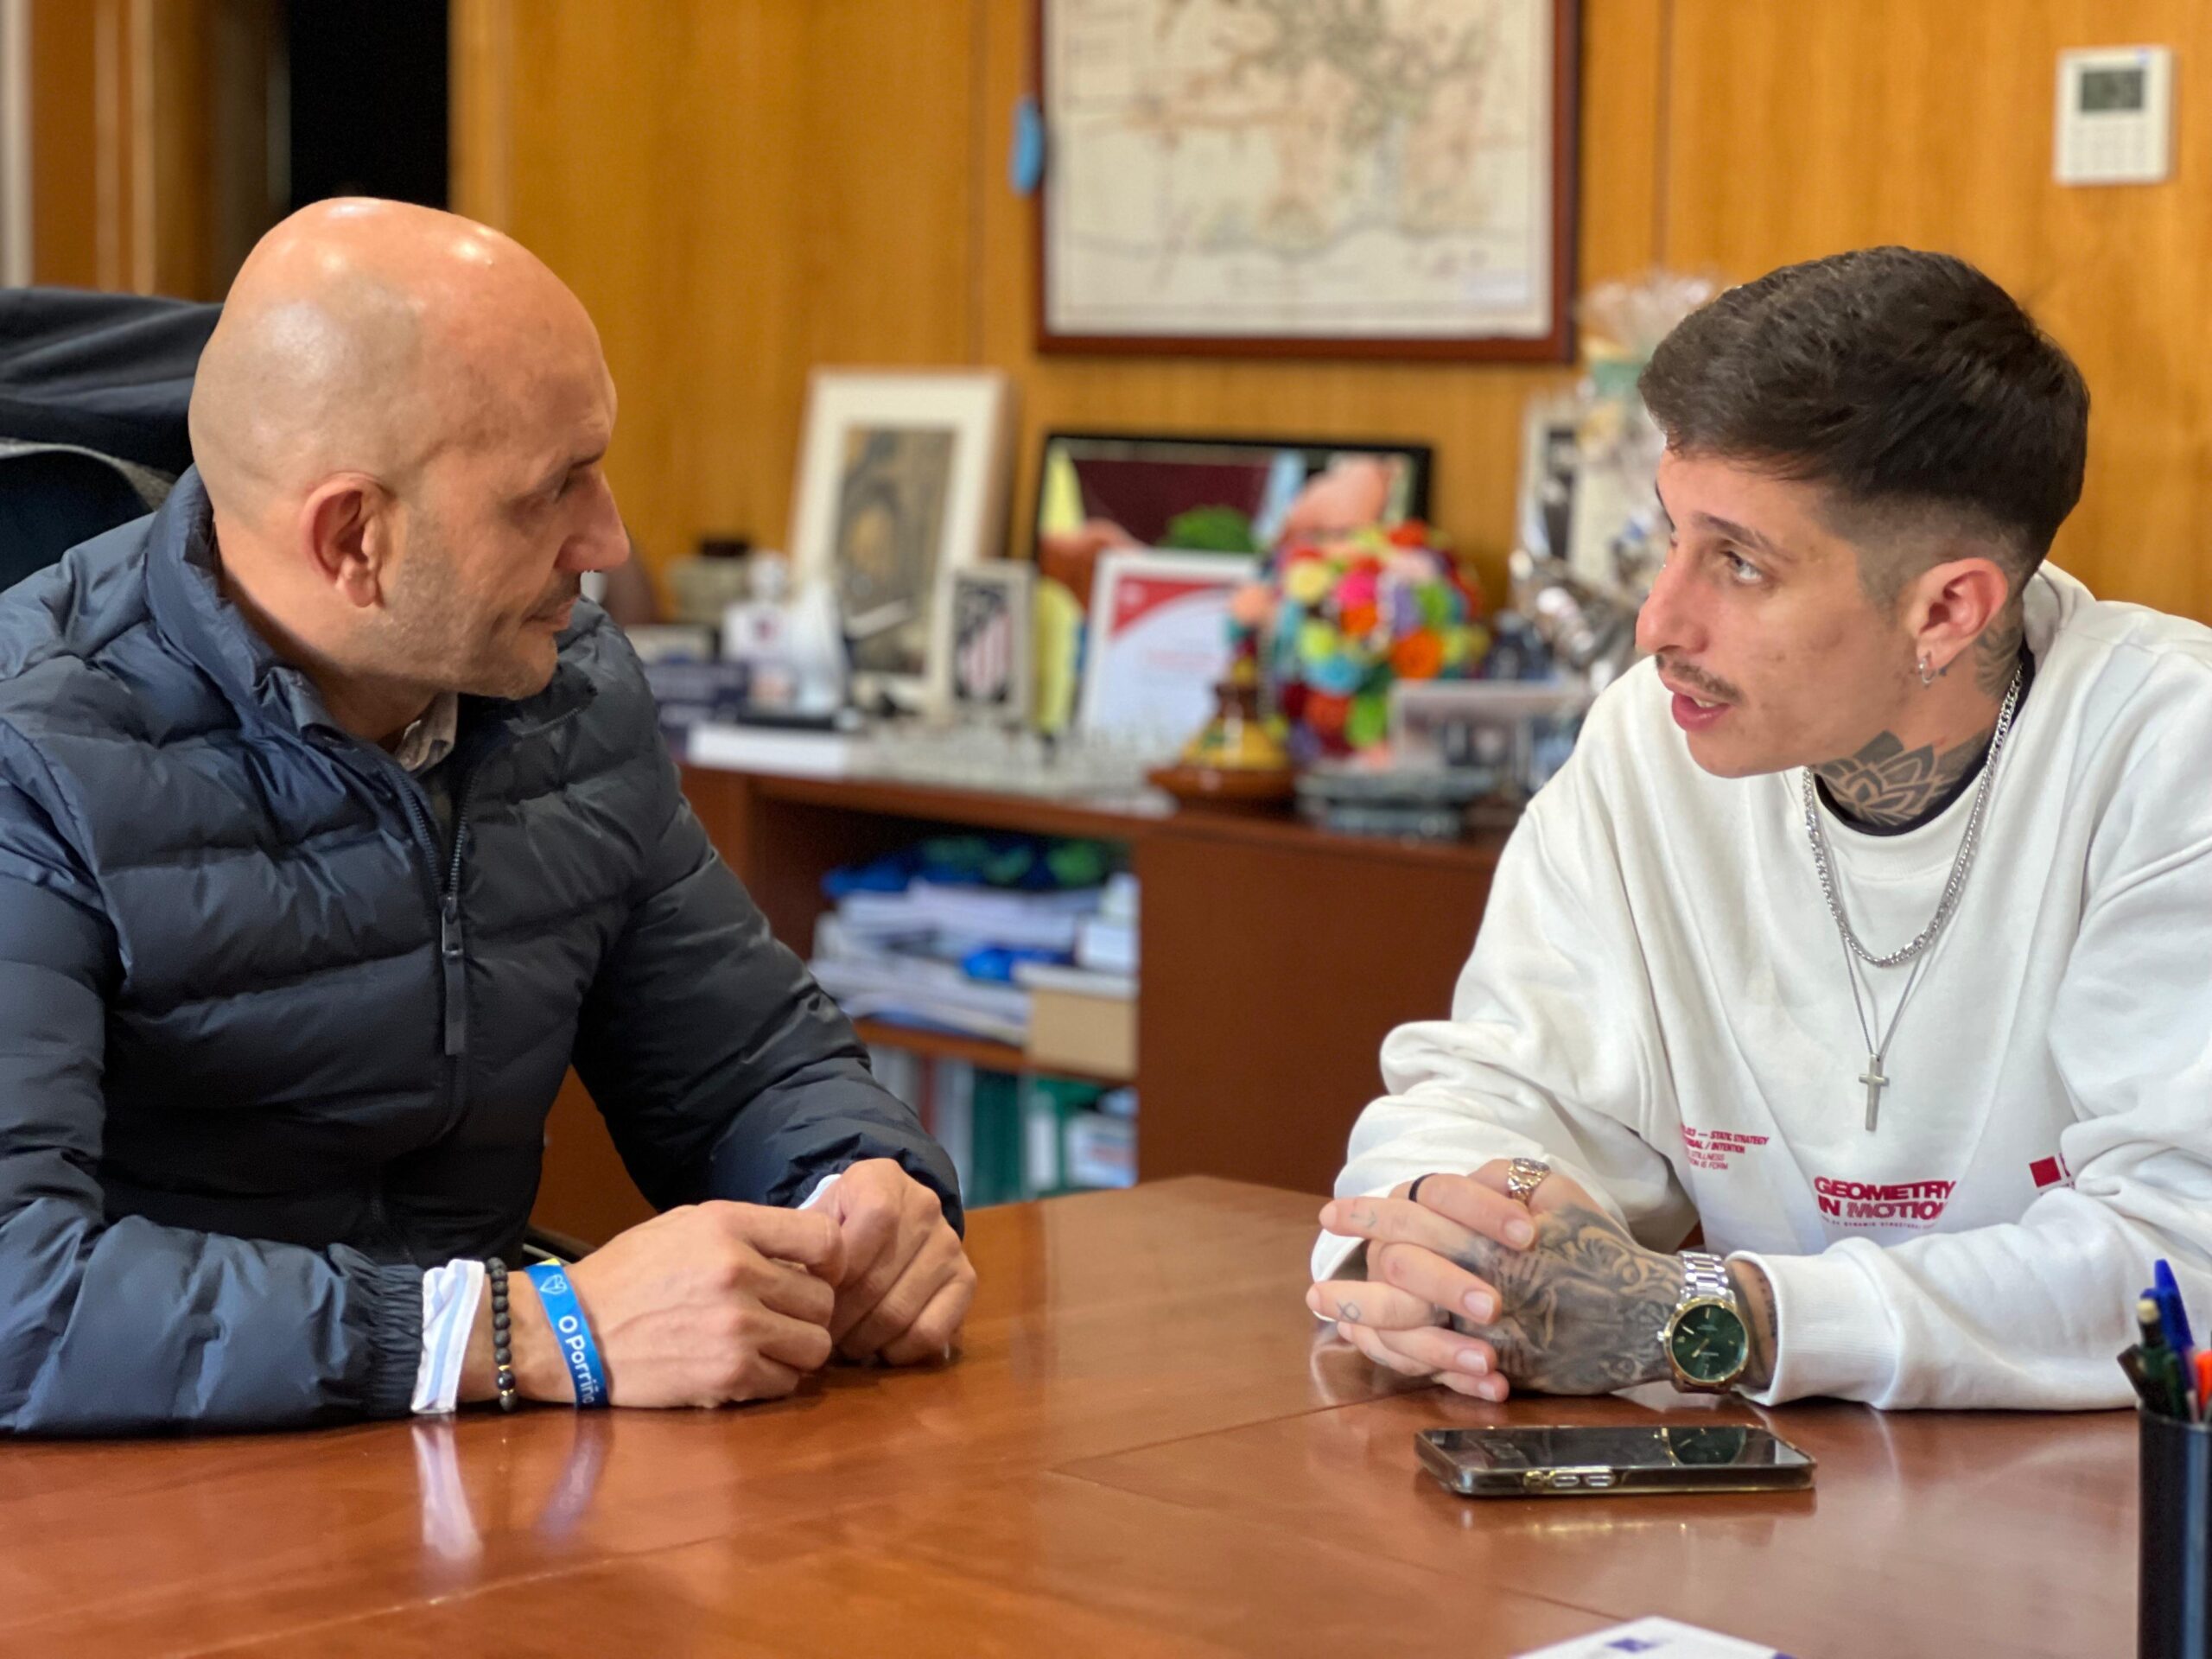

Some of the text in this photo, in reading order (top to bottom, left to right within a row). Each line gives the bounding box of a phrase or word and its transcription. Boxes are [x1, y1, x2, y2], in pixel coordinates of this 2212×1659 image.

[1711, 1131, 1732, 1141] STATIC
[1733, 1134, 1770, 1146] STRATEGY
[1691, 1151, 1724, 1160] STILLNESS
[1711, 1142, 1745, 1154] INTENTION
[1708, 1161, 1728, 1170] FORM
[1814, 1176, 1957, 1201] GEOMETRY
[1817, 1195, 1841, 1217] IN
[558, 1315, 600, 1405] O Porriño
